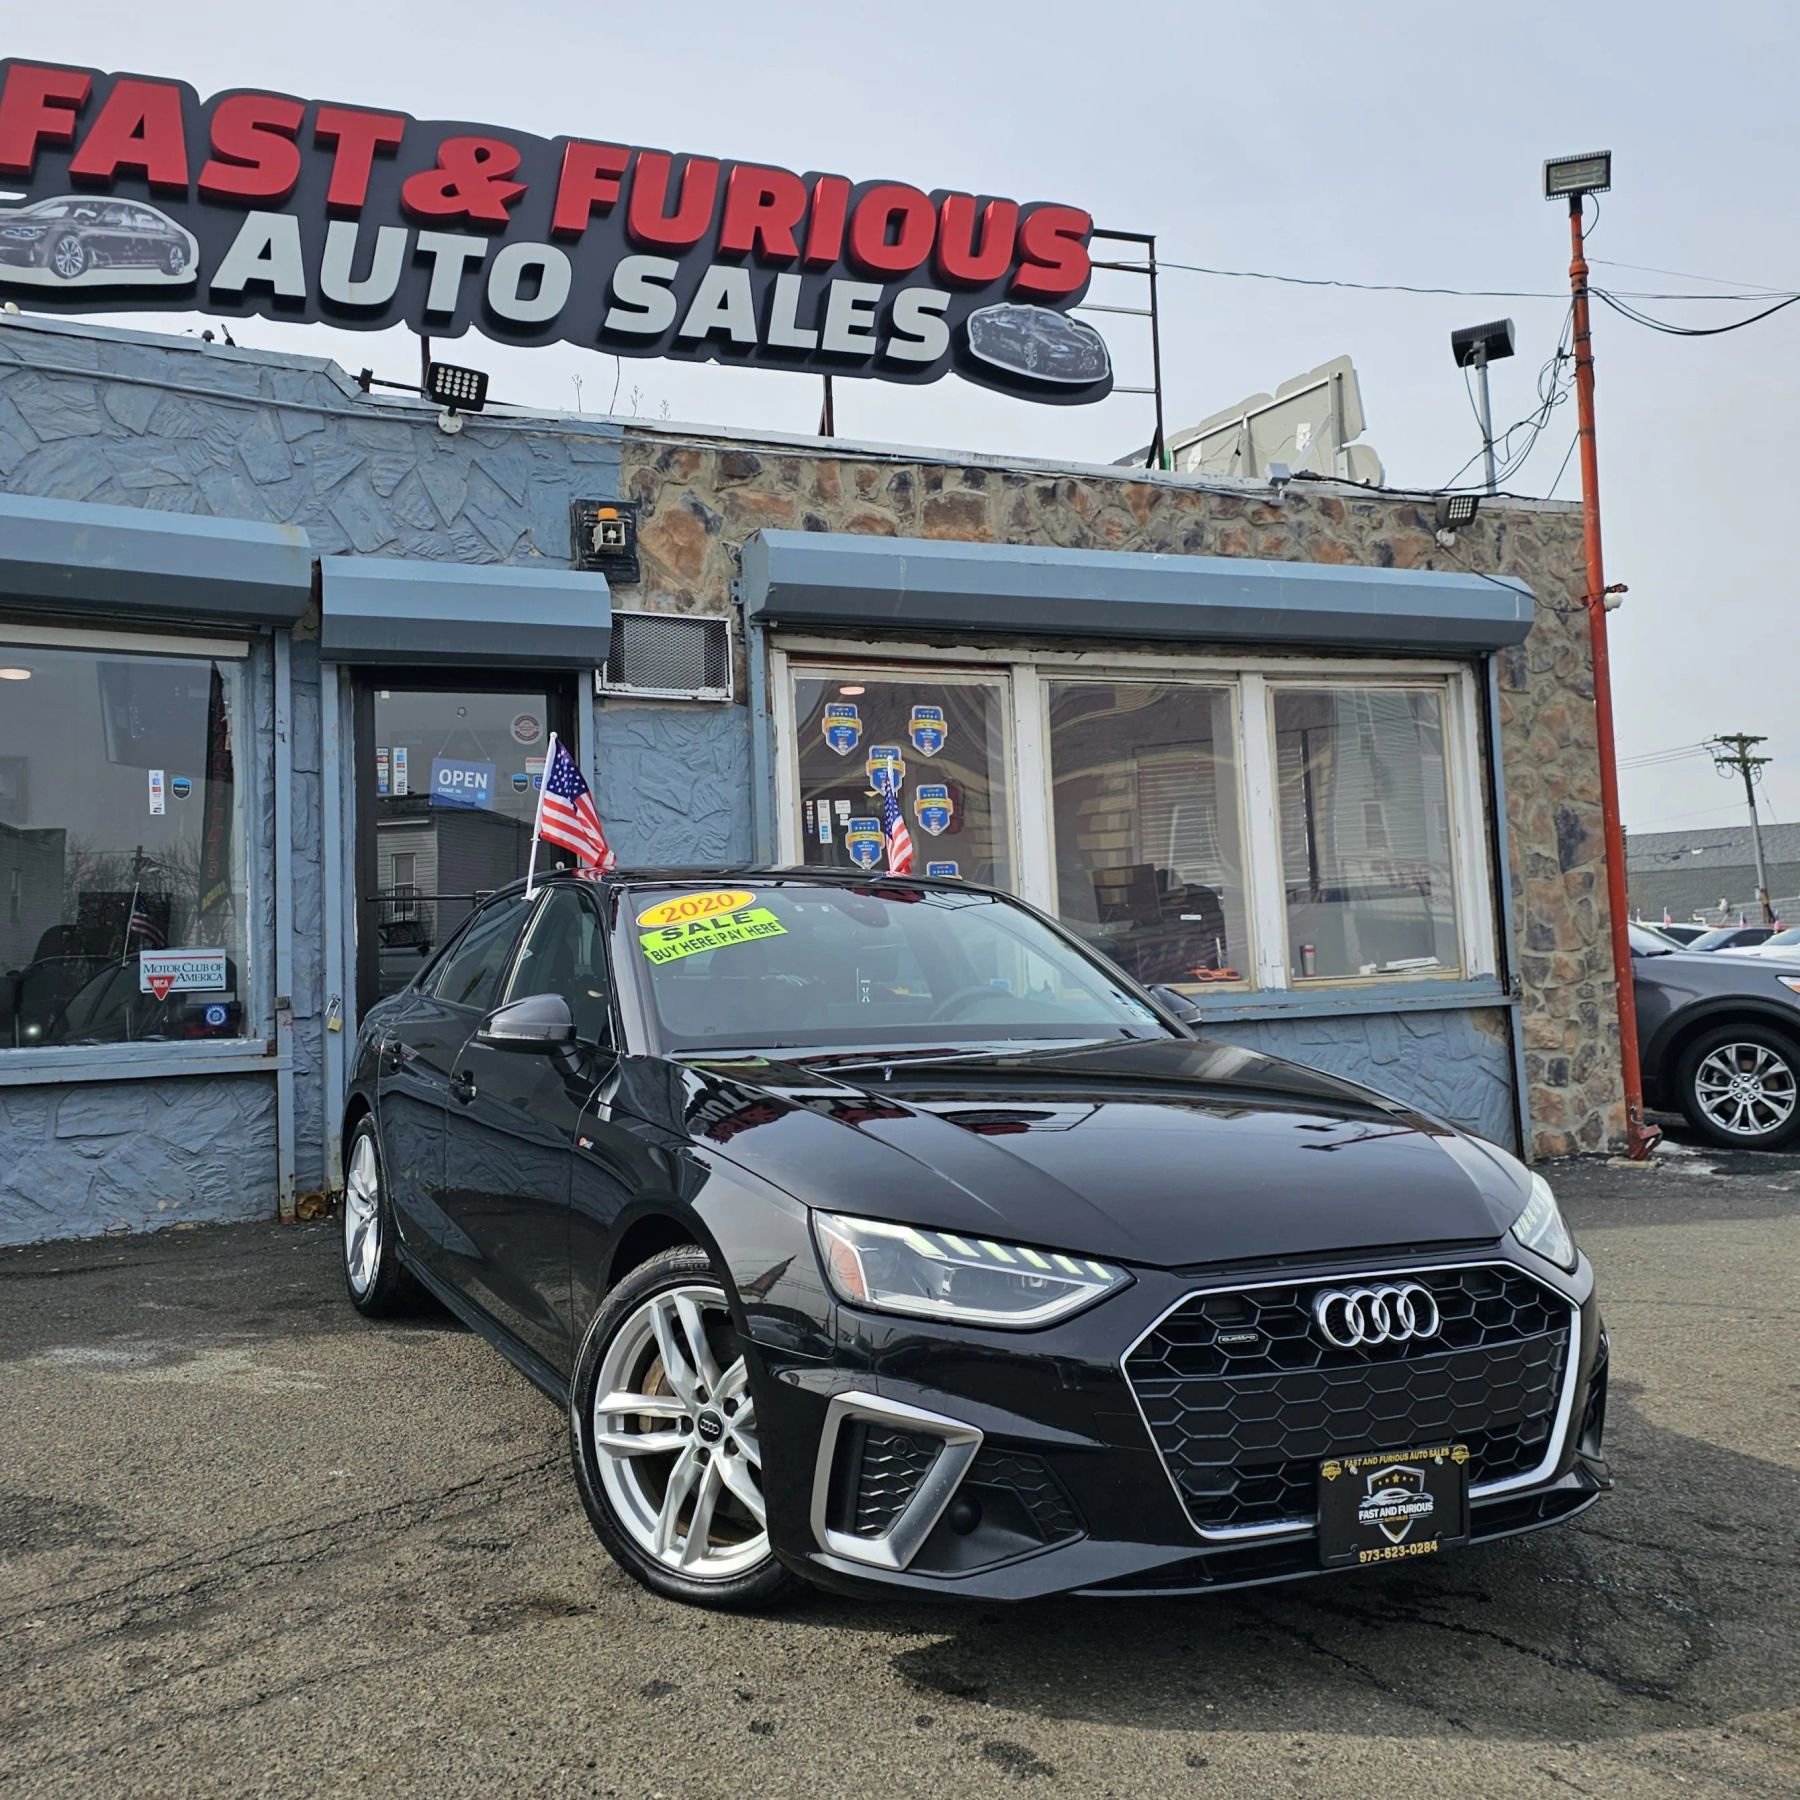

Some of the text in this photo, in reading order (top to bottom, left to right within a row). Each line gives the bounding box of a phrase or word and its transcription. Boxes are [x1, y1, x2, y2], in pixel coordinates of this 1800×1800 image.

[0, 63, 1093, 298] FAST & FURIOUS
[209, 210, 952, 363] AUTO SALES
[438, 768, 488, 789] OPEN
[660, 893, 735, 924] 2020
[661, 912, 753, 941] SALE
[650, 944, 681, 962] BUY
[747, 922, 780, 937] HERE
[143, 962, 224, 974] MOTOR CLUB OF
[175, 973, 224, 982] AMERICA
[152, 979, 169, 988] MCA
[1344, 1458, 1363, 1468] FAST
[1362, 1456, 1379, 1466] AND
[1379, 1452, 1409, 1464] FURIOUS
[1409, 1450, 1428, 1460] AUTO
[1428, 1447, 1450, 1458] SALES
[1358, 1501, 1434, 1520] FAST AND FURIOUS
[1359, 1540, 1438, 1563] 973-623-0284
